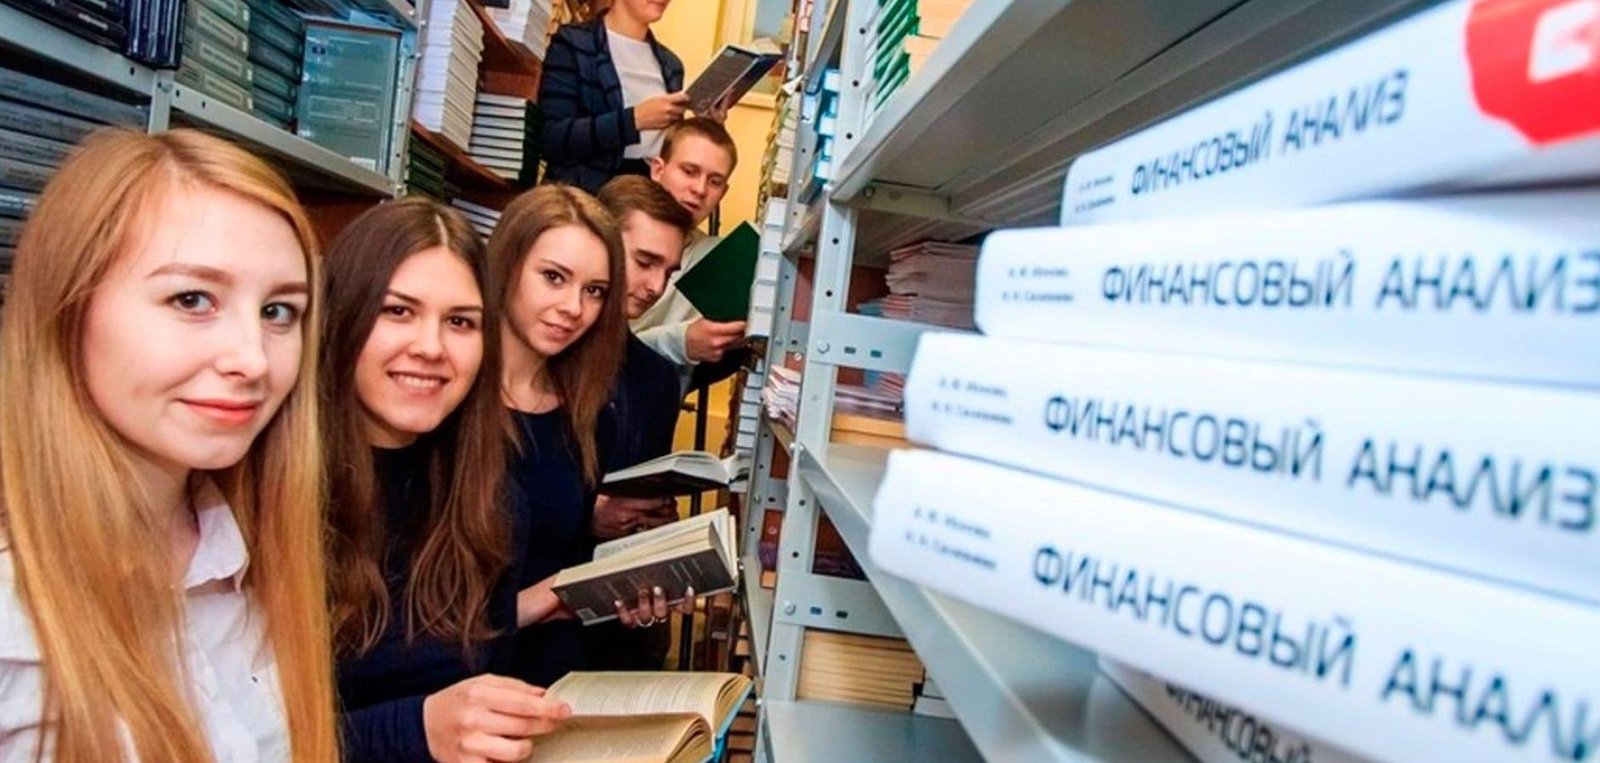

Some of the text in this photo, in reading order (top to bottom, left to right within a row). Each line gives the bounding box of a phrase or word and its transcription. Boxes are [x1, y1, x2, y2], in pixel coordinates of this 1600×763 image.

[1131, 69, 1408, 196] ФИНАНСОВЫЙ АНАЛИЗ
[1101, 247, 1600, 315] ФИНАНСОВЫЙ АНАЛИЗ
[1045, 394, 1597, 534] ФИНАНСОВЫЙ АНАЛИЗ
[1031, 545, 1358, 688] ФИНАНСОВЫЙ
